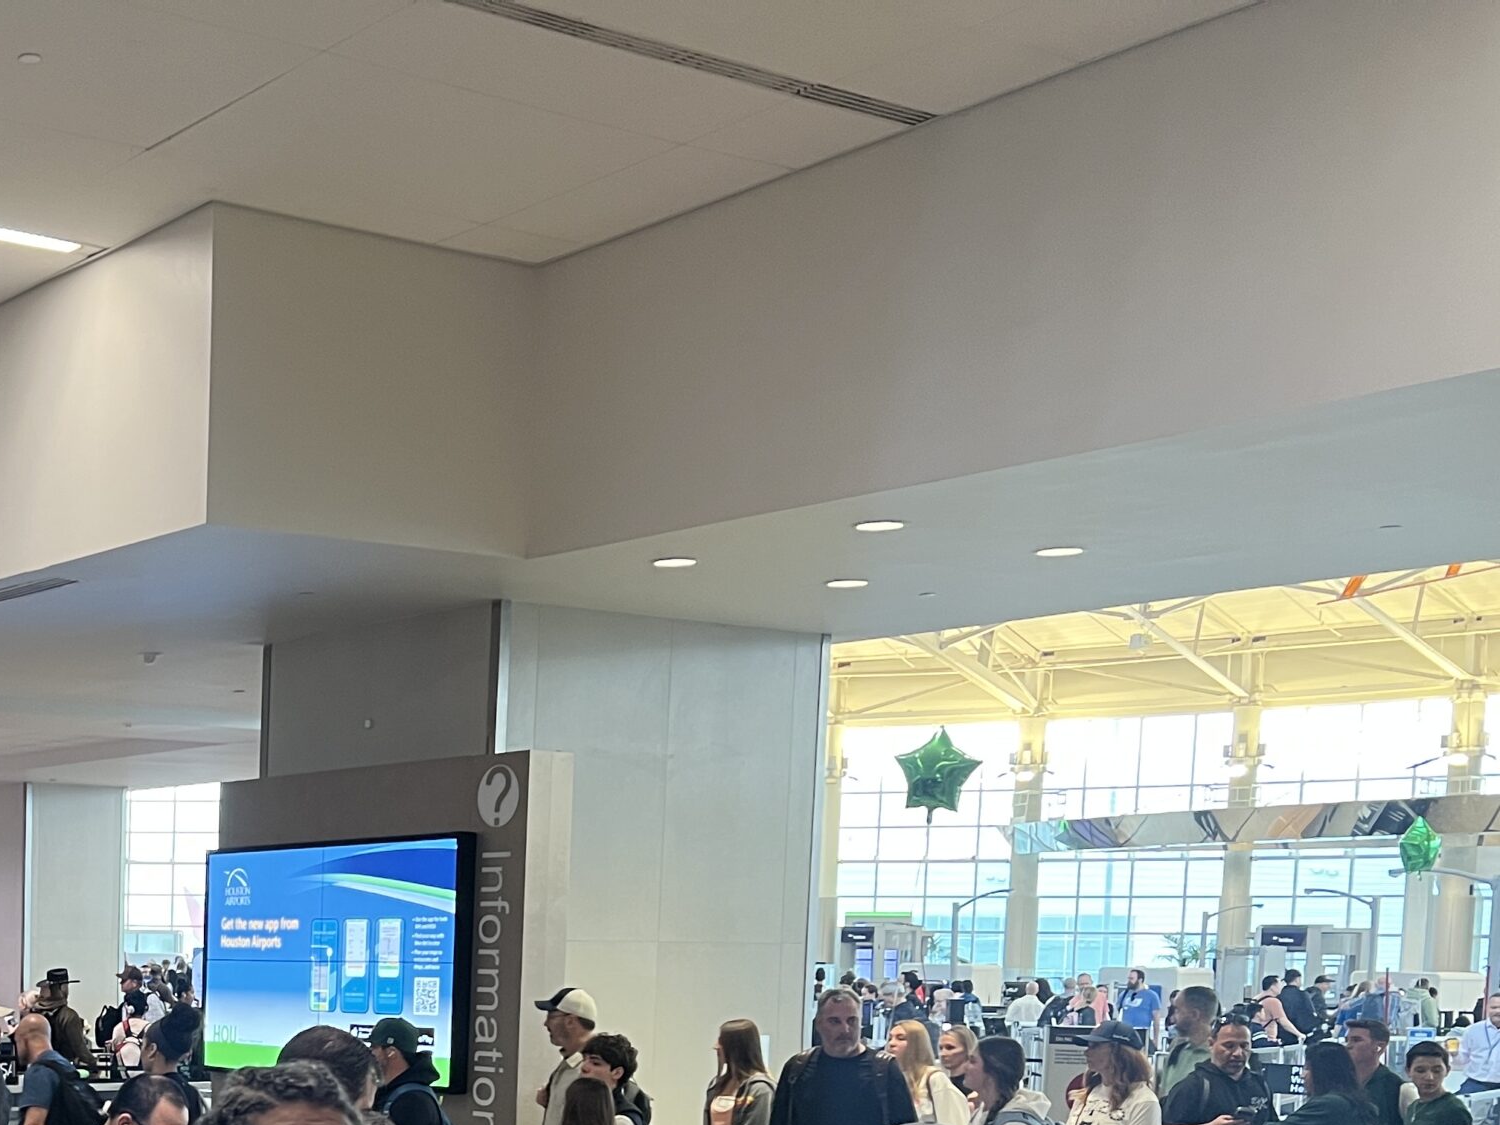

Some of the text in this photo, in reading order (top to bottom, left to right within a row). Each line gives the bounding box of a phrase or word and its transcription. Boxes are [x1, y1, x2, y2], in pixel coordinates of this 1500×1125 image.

[225, 887, 251, 896] HOUSTON
[221, 917, 299, 934] Get the new app from
[221, 935, 282, 951] Houston Airports
[212, 1024, 237, 1043] HOU
